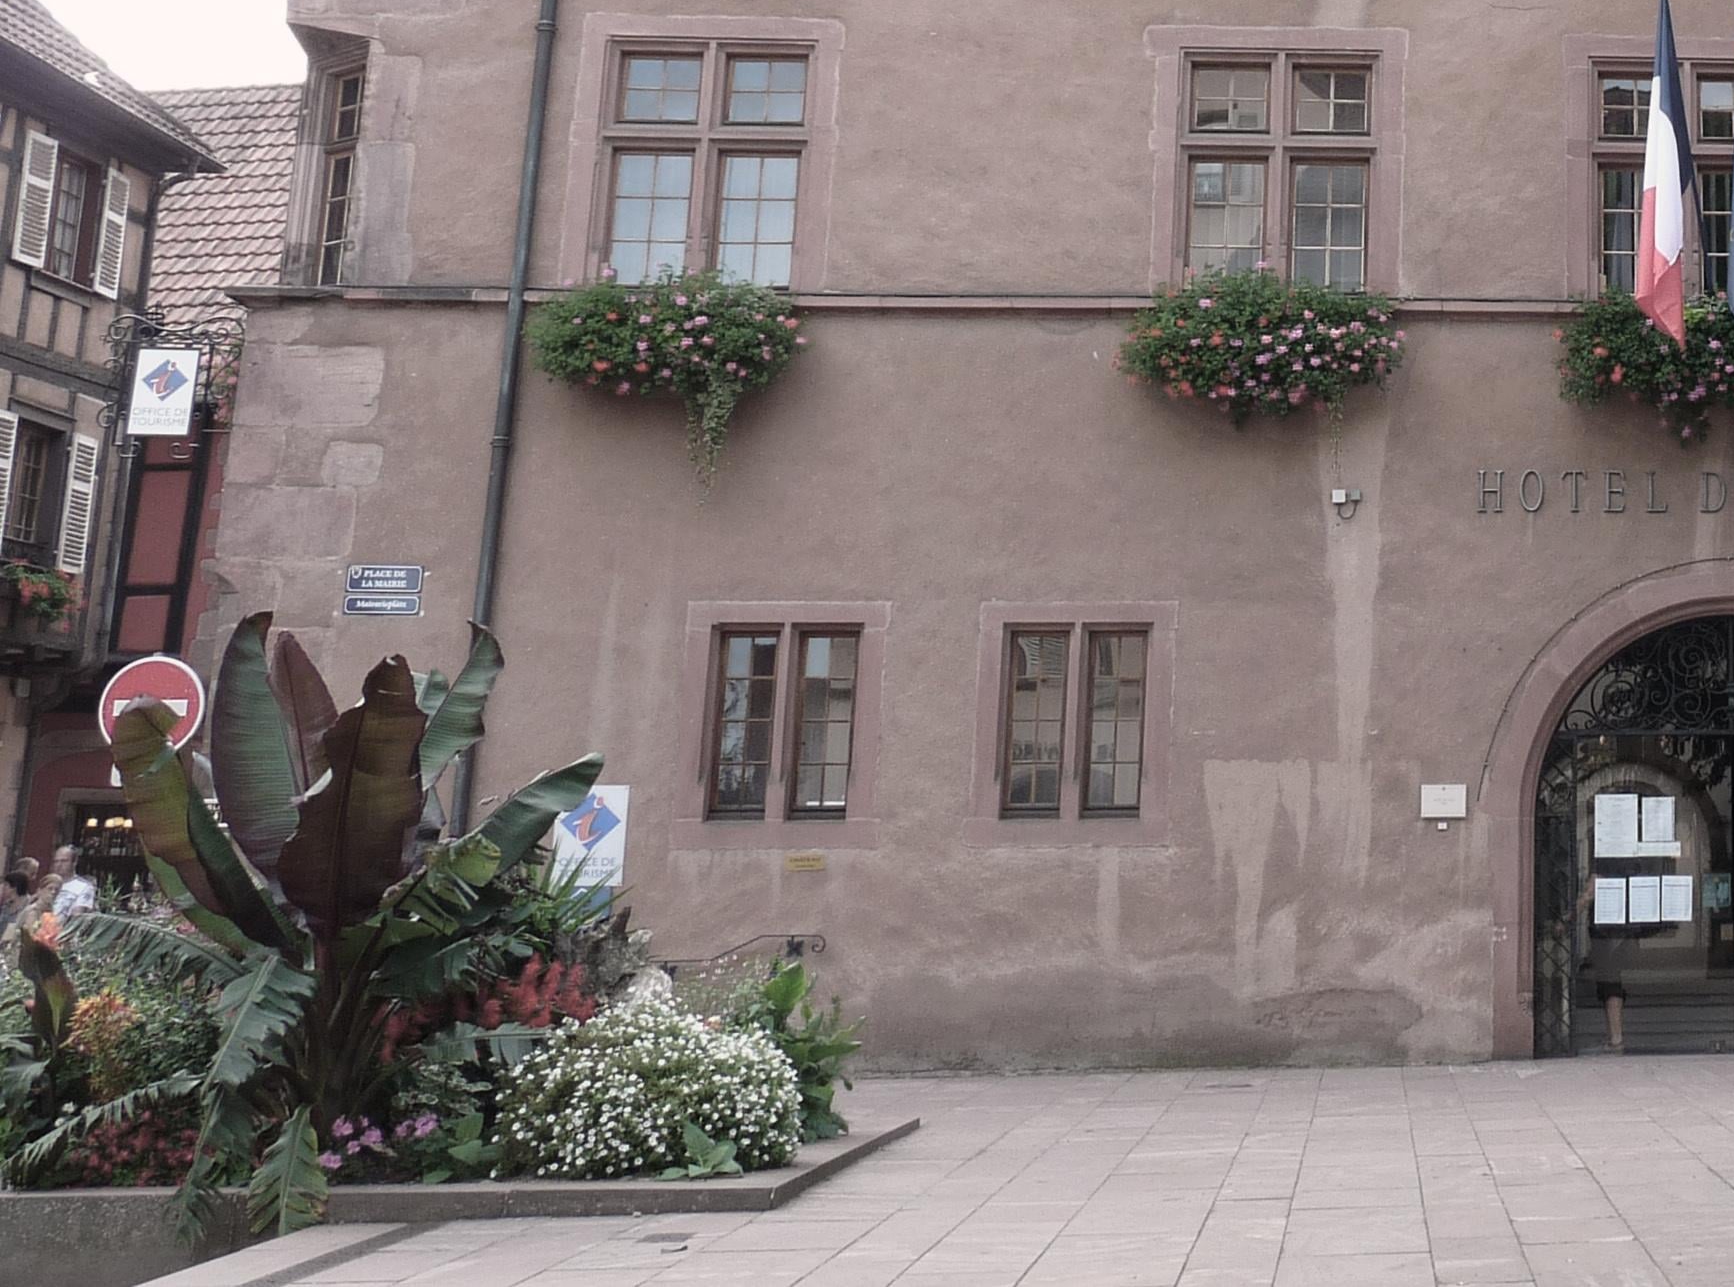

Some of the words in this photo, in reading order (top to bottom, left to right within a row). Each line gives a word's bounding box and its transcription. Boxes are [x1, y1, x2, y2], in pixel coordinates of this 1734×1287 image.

[132, 407, 170, 417] OFFICE
[174, 408, 188, 417] DE
[131, 417, 188, 427] TOURISME
[1477, 469, 1668, 514] HOTEL
[363, 569, 393, 578] PLACE
[394, 569, 407, 578] DE
[361, 579, 373, 588] LA
[374, 579, 407, 588] MAIRIE
[601, 857, 617, 867] DE
